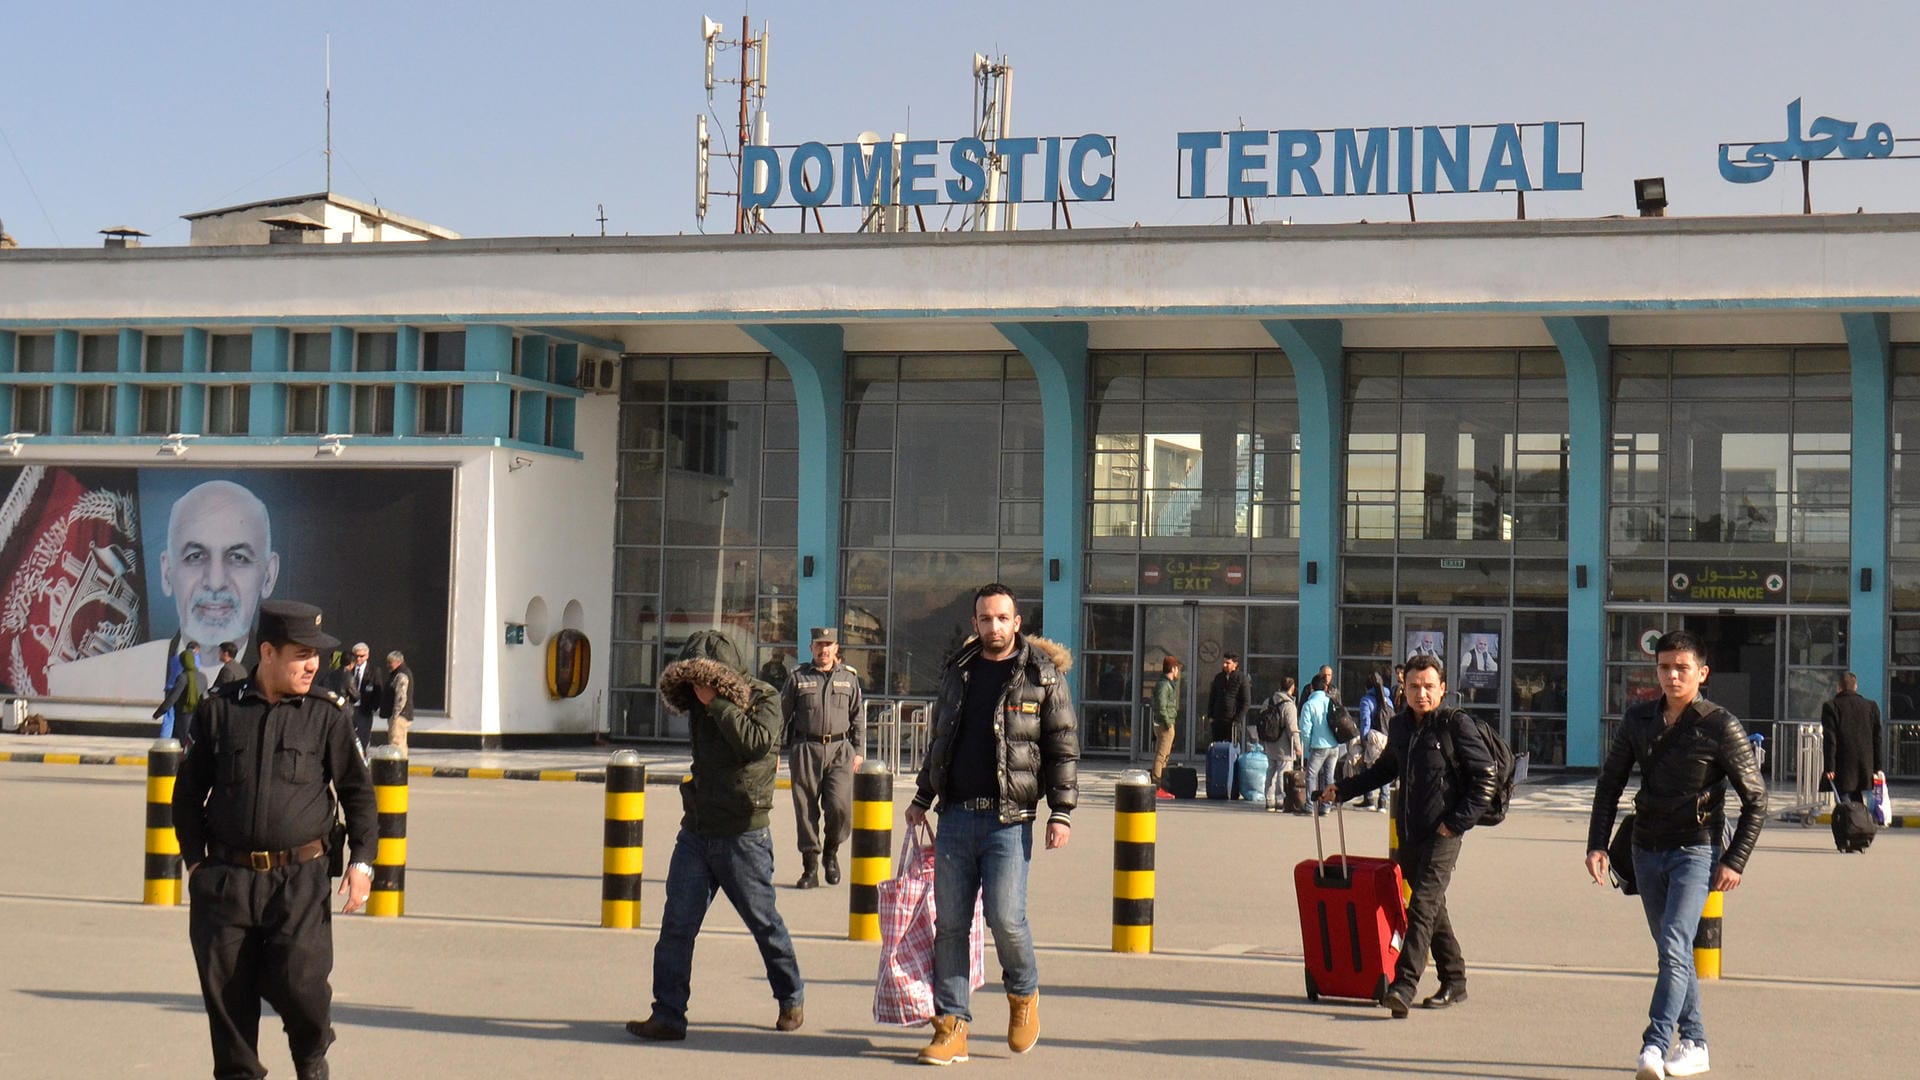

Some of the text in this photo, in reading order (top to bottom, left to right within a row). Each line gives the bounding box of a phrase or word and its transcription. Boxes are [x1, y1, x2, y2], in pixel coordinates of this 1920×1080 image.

[741, 121, 1584, 209] DOMESTIC TERMINAL
[1173, 577, 1212, 591] EXIT
[1690, 586, 1764, 599] ENTRANCE
